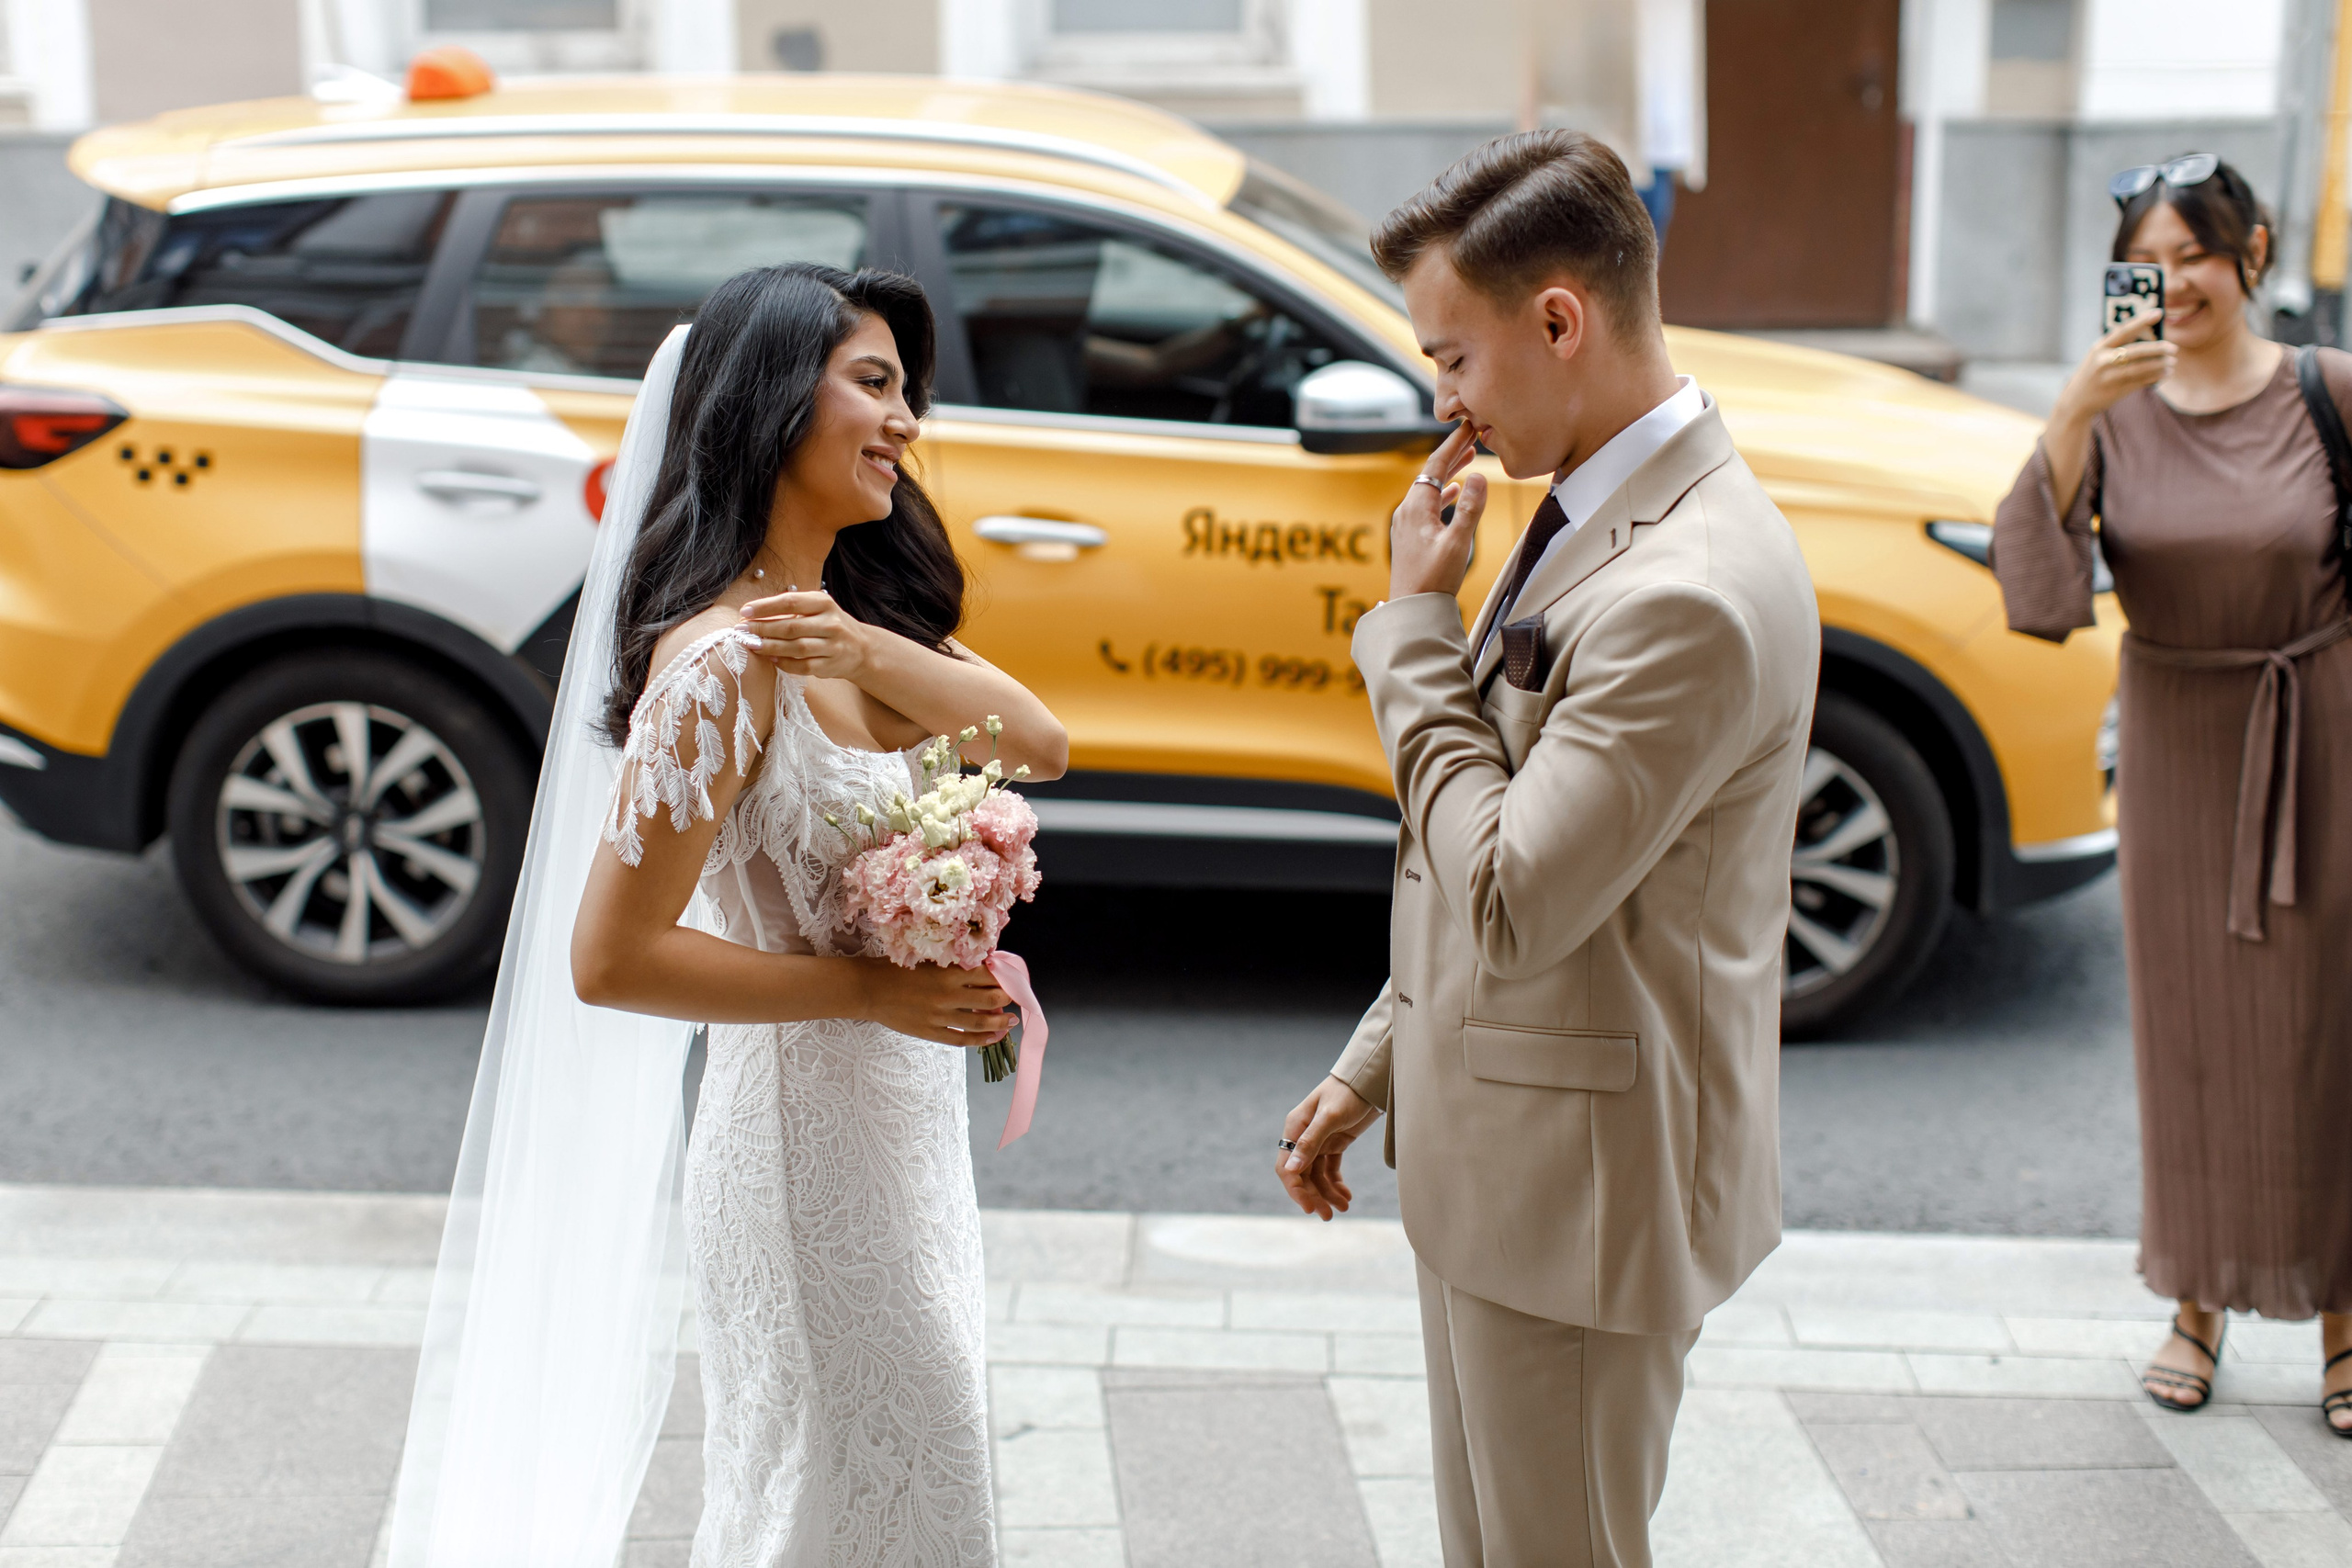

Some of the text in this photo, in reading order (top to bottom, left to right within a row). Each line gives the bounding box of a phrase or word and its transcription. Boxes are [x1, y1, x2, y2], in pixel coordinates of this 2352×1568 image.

[1182, 507, 1371, 567] Яндекс
[1316, 584, 1367, 637] Та
[1144, 643, 1368, 695] (495) 999-9
